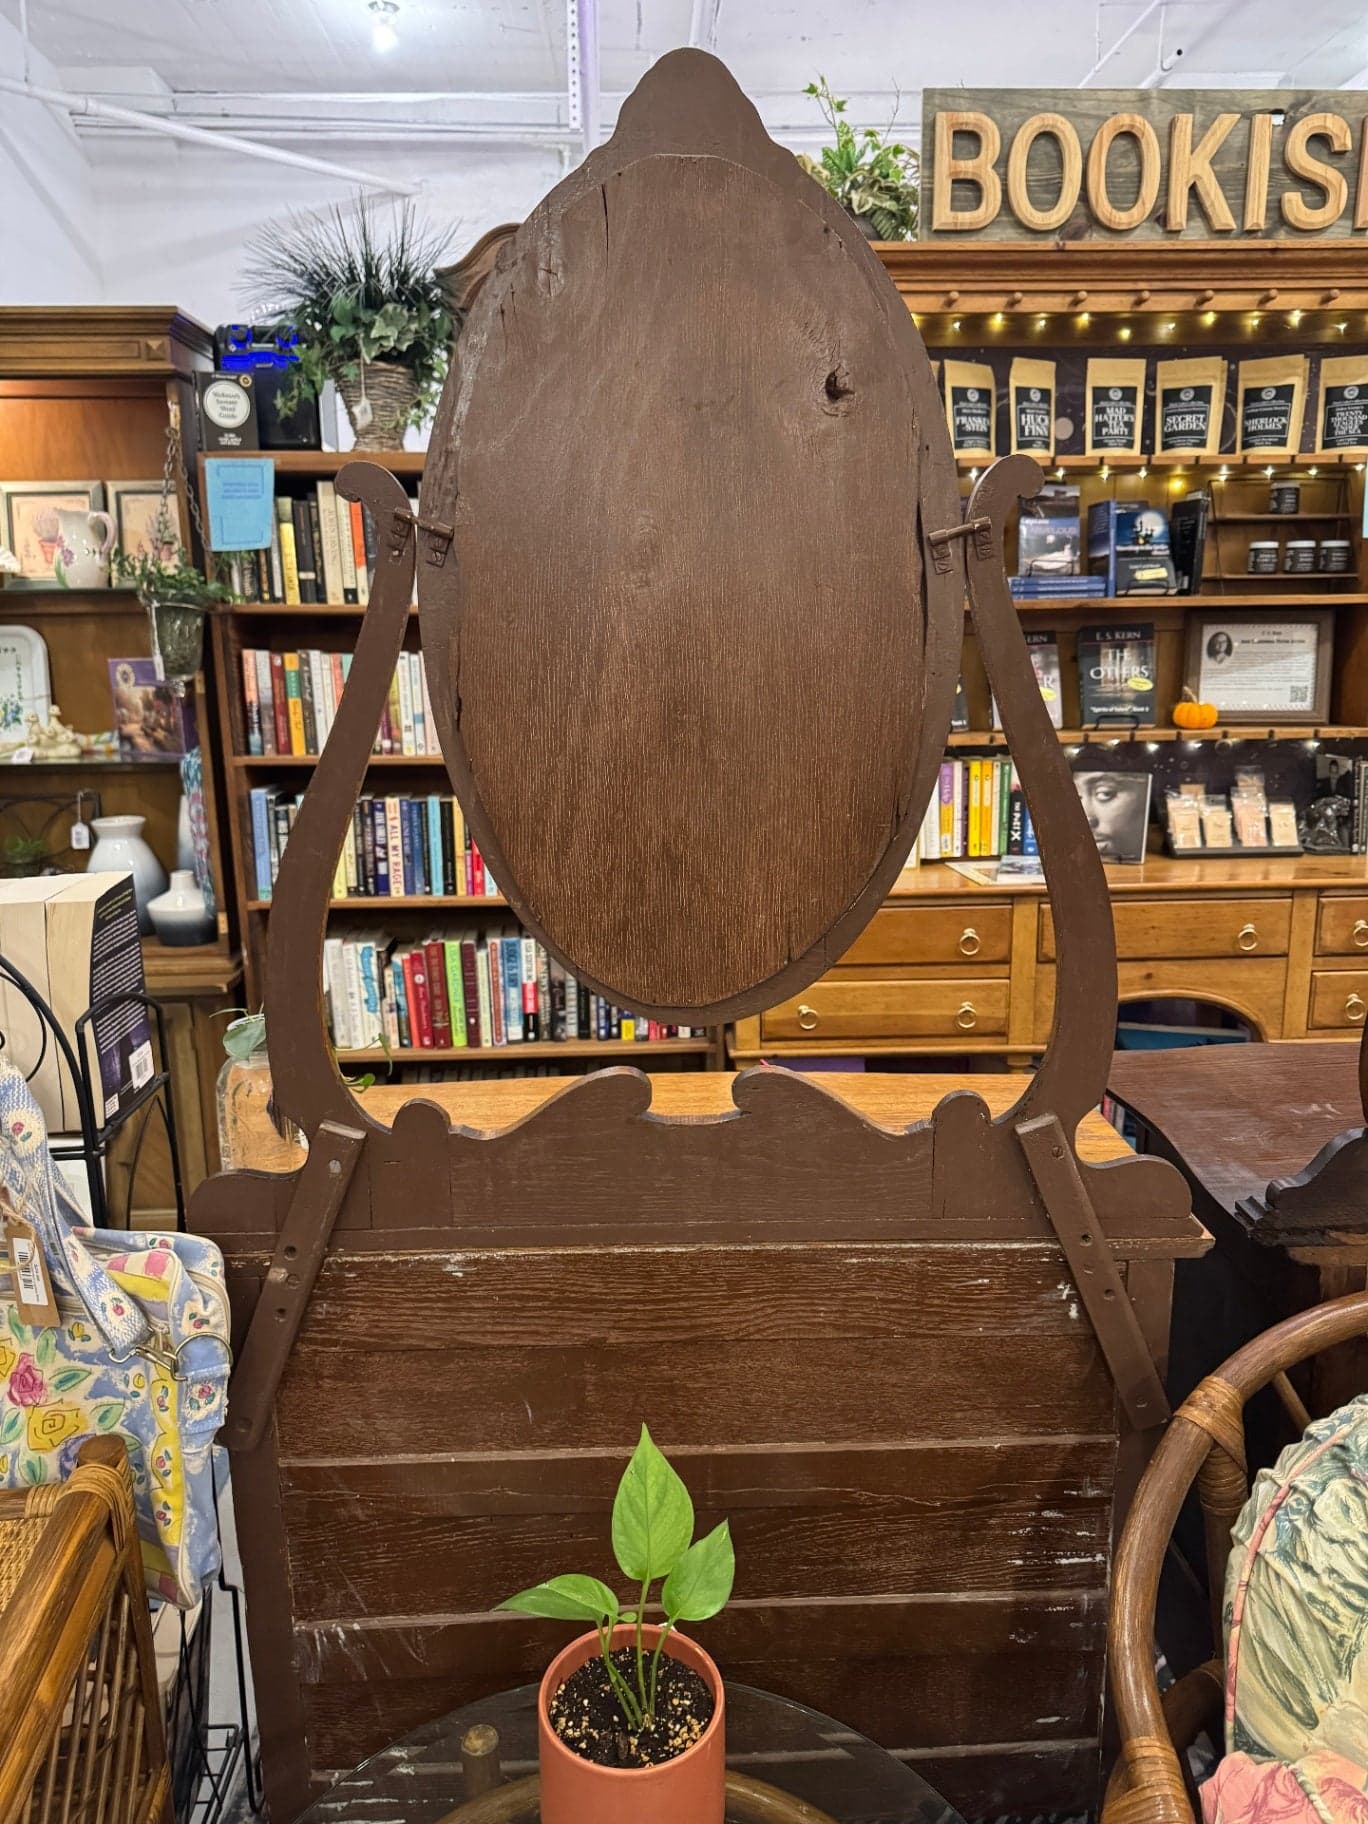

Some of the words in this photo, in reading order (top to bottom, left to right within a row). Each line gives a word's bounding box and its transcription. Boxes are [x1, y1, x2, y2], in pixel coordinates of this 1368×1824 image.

[932, 111, 1368, 231] BOOKIS
[1165, 413, 1206, 425] SECRET
[1164, 421, 1206, 433] GARDEN
[1247, 422, 1282, 433] HOLMES
[1026, 634, 1048, 644] ERN
[1115, 631, 1141, 640] KERN
[1089, 665, 1150, 681] OTHERS
[390, 825, 399, 840] ALL
[1011, 830, 1021, 841] X
[392, 845, 400, 858] MY
[393, 862, 402, 886] RAGE
[506, 942, 518, 963] JUDGE
